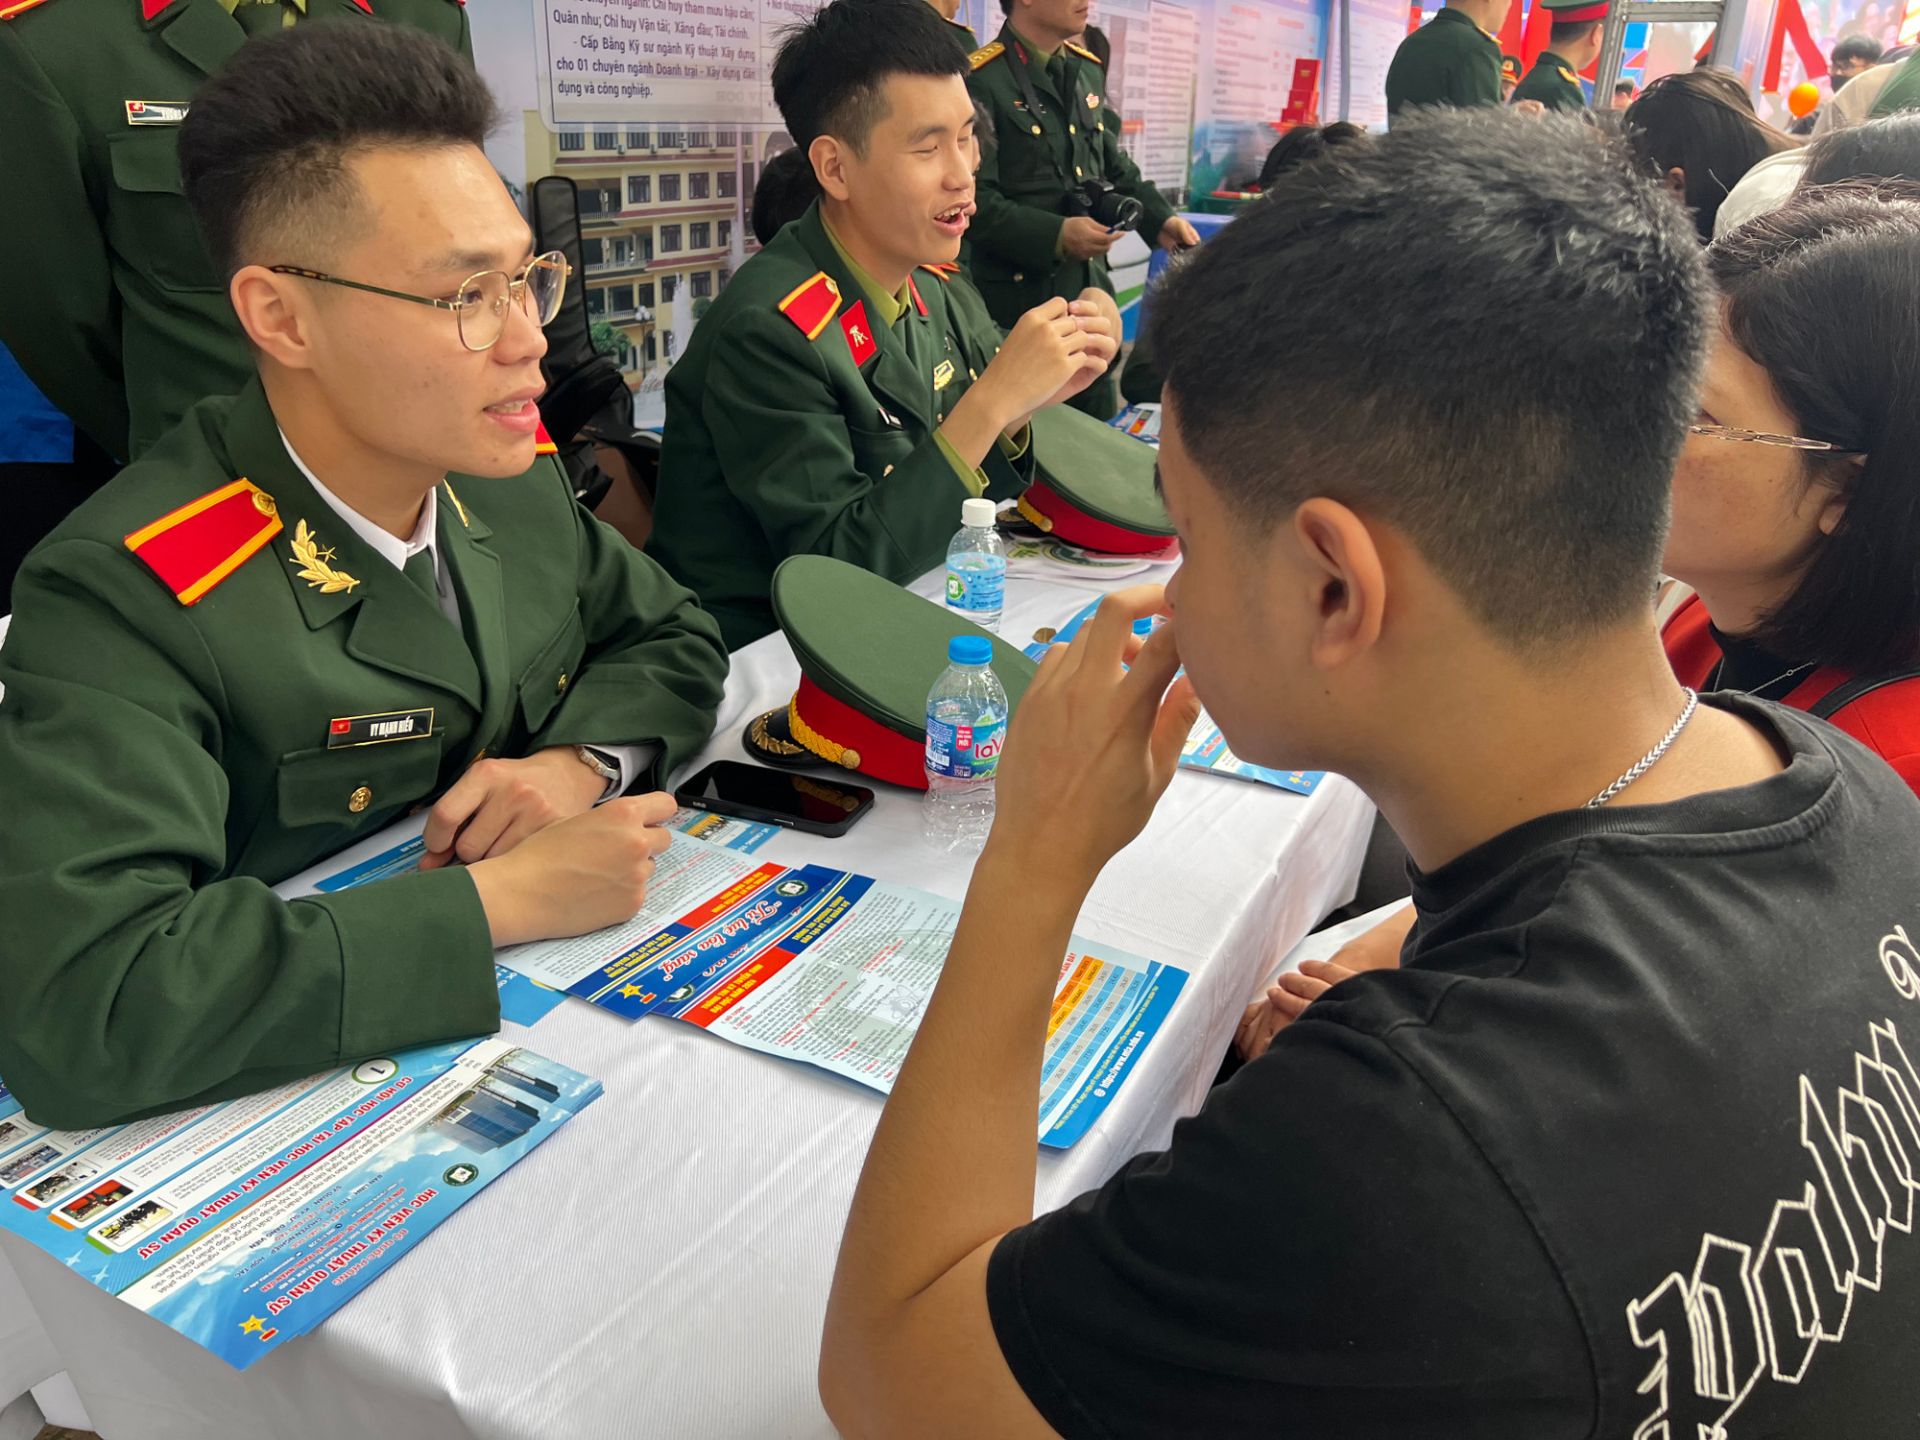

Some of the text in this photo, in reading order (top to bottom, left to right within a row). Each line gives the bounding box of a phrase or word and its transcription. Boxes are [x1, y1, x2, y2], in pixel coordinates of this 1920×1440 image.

[668, 0, 682, 14] huy
[685, 2, 704, 14] tham
[707, 5, 723, 16] mưu
[553, 9, 578, 24] Quân
[581, 12, 601, 28] nhu;
[621, 15, 636, 32] huy
[638, 18, 655, 32] Vận
[580, 34, 598, 52] Cấp
[643, 42, 654, 53] sư
[657, 43, 682, 57] ngành
[698, 45, 718, 60] thuật
[721, 45, 735, 61] Xây
[556, 57, 574, 71] cho
[577, 58, 588, 71] 01
[592, 58, 625, 76] chuyên
[627, 61, 654, 77] ngành
[656, 63, 682, 76] Doanh
[684, 65, 698, 79] trại
[706, 66, 720, 80] Xây
[558, 80, 582, 96] dụng
[584, 81, 595, 94] và
[597, 82, 619, 98] công
[723, 918, 748, 936] tuệ
[396, 1077, 412, 1089] CƠ
[376, 1087, 396, 1100] HỘI
[354, 1099, 378, 1116] HỌC
[333, 1116, 355, 1131] TẬP
[312, 1131, 332, 1144] TẠI
[287, 1143, 313, 1160] HỌC
[257, 1160, 288, 1179] VIỆN
[241, 1178, 259, 1191] KỸ
[200, 1191, 240, 1218] THUẬT
[410, 1189, 436, 1207] HỌC
[383, 1208, 412, 1229] VIỆN
[161, 1217, 199, 1242] QUÂN
[367, 1228, 384, 1243] KỸ
[138, 1242, 160, 1258] SỰ
[327, 1242, 367, 1271] THUẬT
[289, 1270, 327, 1298] QUÂN
[267, 1296, 291, 1314] SỰ
